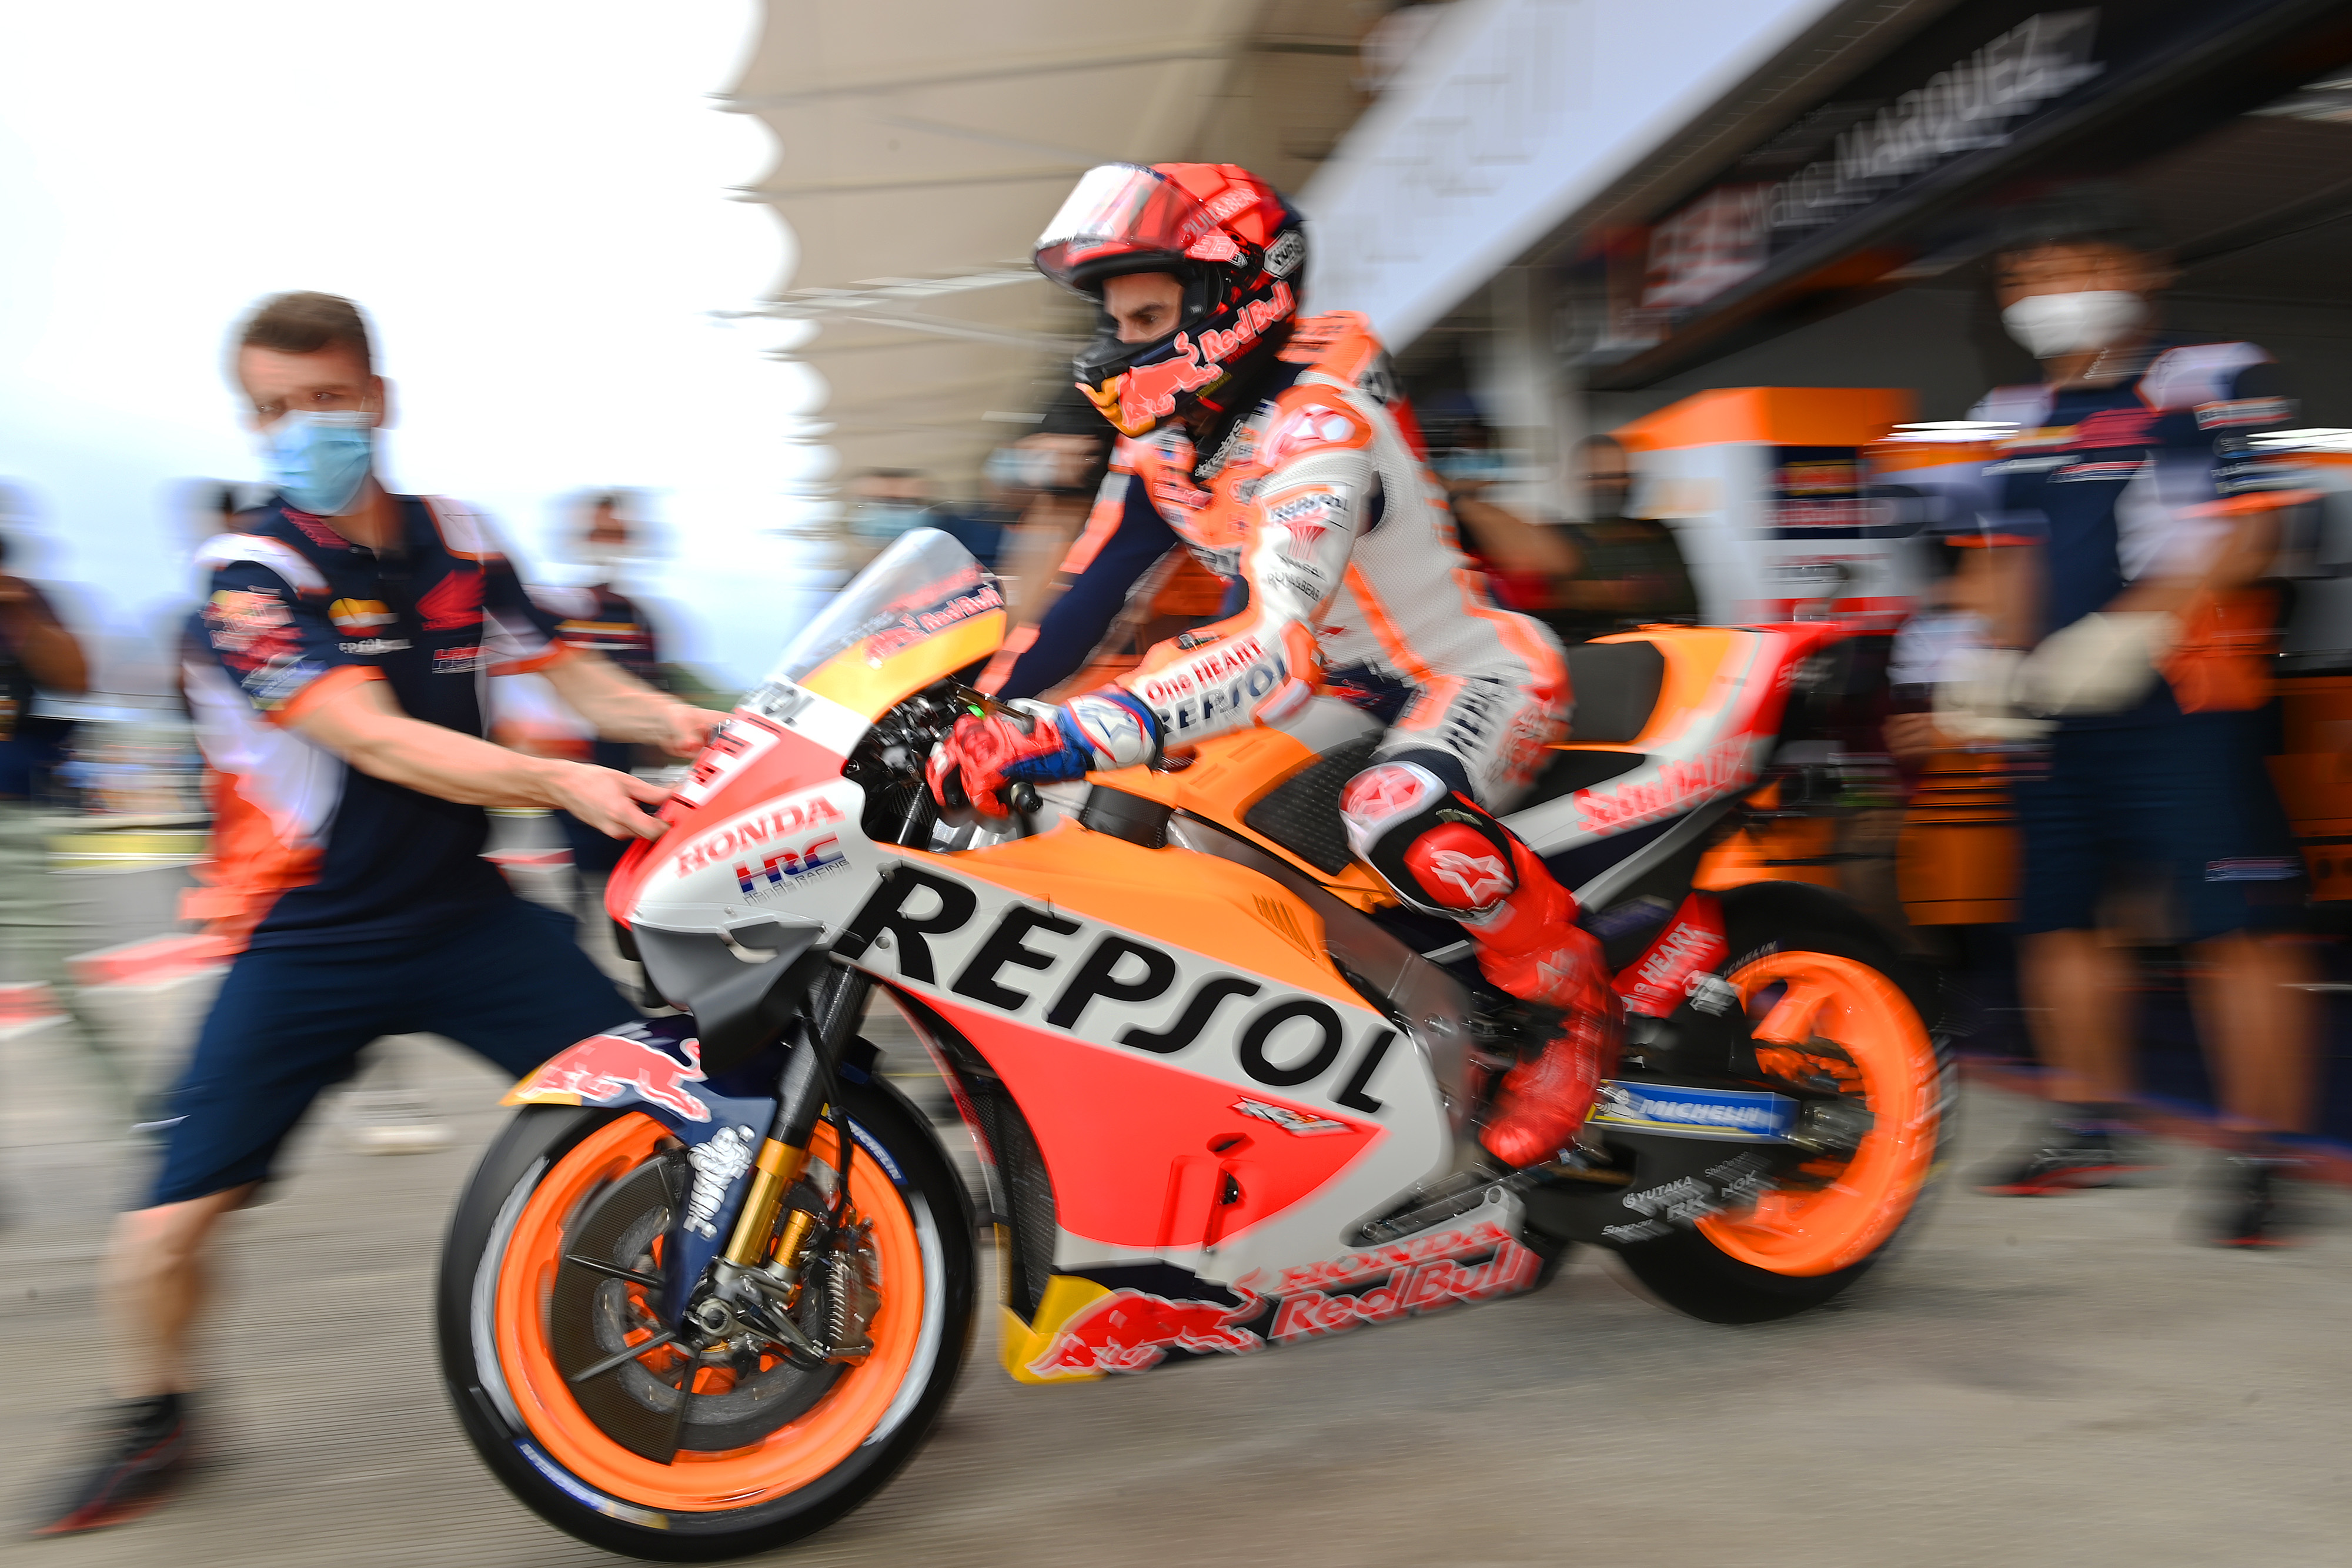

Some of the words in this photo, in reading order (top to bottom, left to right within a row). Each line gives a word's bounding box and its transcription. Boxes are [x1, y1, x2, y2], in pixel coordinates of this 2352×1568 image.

[1198, 306, 1256, 363] Red
[1246, 279, 1296, 334] Bull
[1194, 419, 1244, 477] alpinestars
[335, 637, 383, 654] EPSOL
[1145, 674, 1194, 706] One
[1161, 651, 1287, 734] REPSOL
[674, 794, 846, 880] HONDA
[731, 831, 848, 894] HRC
[1720, 940, 1777, 978] ICHELIN
[831, 865, 1398, 1114] REPSOL
[1638, 1098, 1763, 1123] MICHELIN
[1636, 1175, 1693, 1203] YUTAKA
[1666, 1194, 1706, 1221] RK
[1720, 1170, 1756, 1199] NGK
[1601, 1218, 1654, 1236] Snap-on
[1272, 1219, 1516, 1295] HONDA
[1267, 1263, 1411, 1343] Red
[1401, 1238, 1532, 1318] Bull
